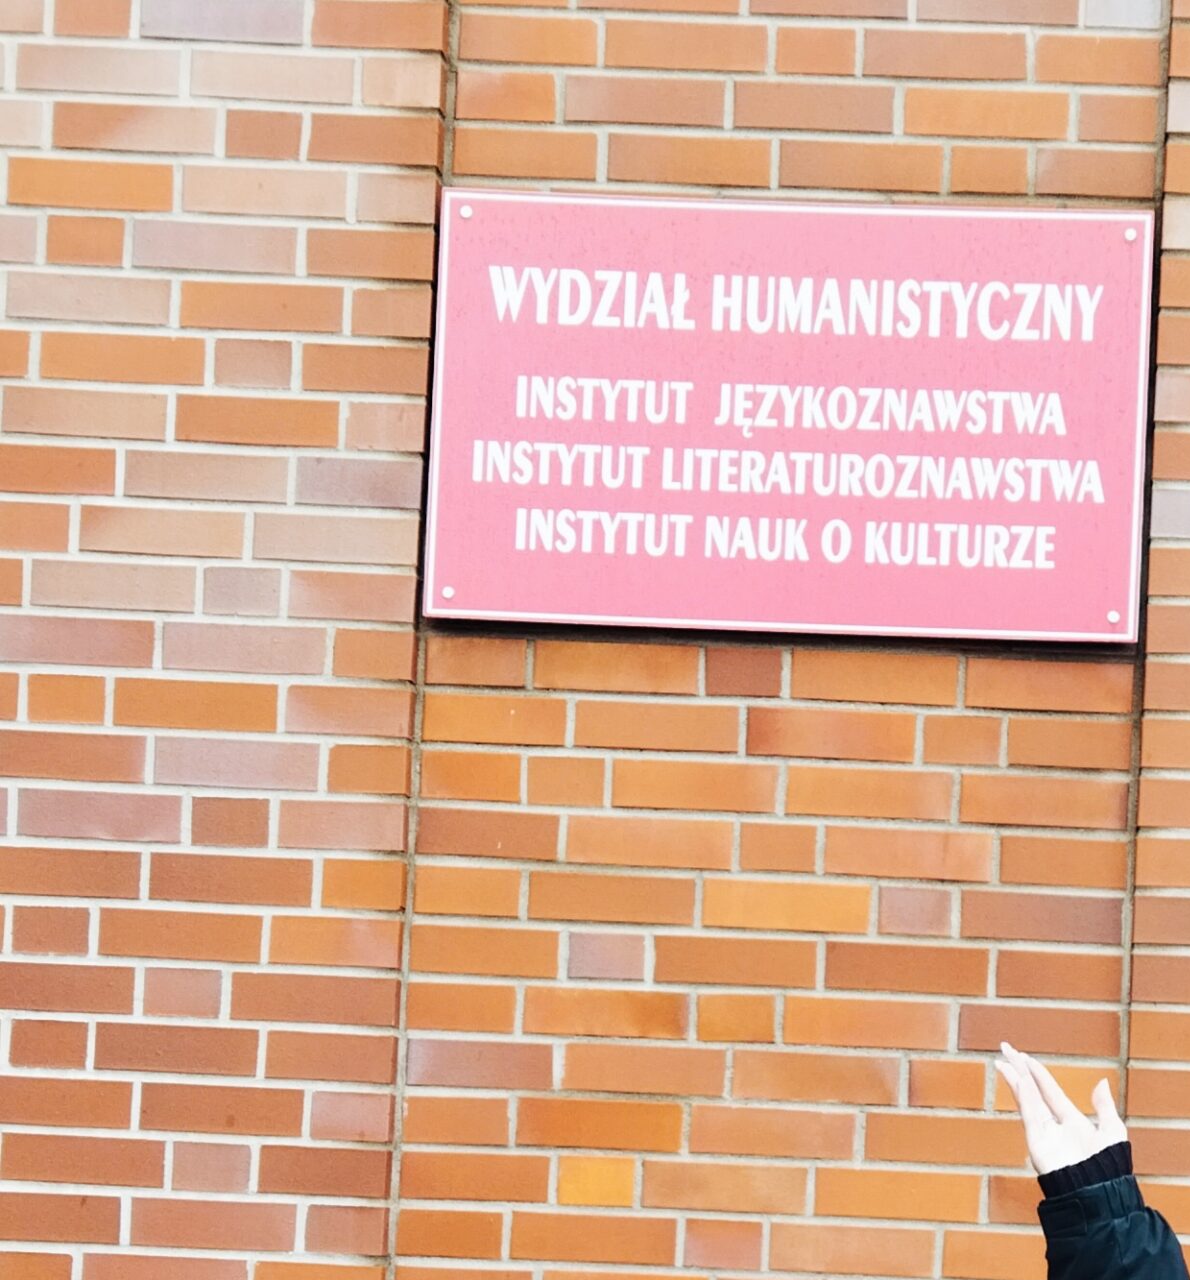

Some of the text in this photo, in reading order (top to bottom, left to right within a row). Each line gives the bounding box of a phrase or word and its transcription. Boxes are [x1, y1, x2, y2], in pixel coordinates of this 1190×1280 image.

[489, 266, 1103, 341] WYDZIAŁ HUMANISTYCZNY
[516, 376, 1066, 438] INSTYTUT JĘZYKOZNAWSTWA
[473, 440, 1104, 503] INSTYTUT LITERATUROZNAWSTWA
[516, 508, 1055, 568] INSTYTUT NAUK O KULTURZE
